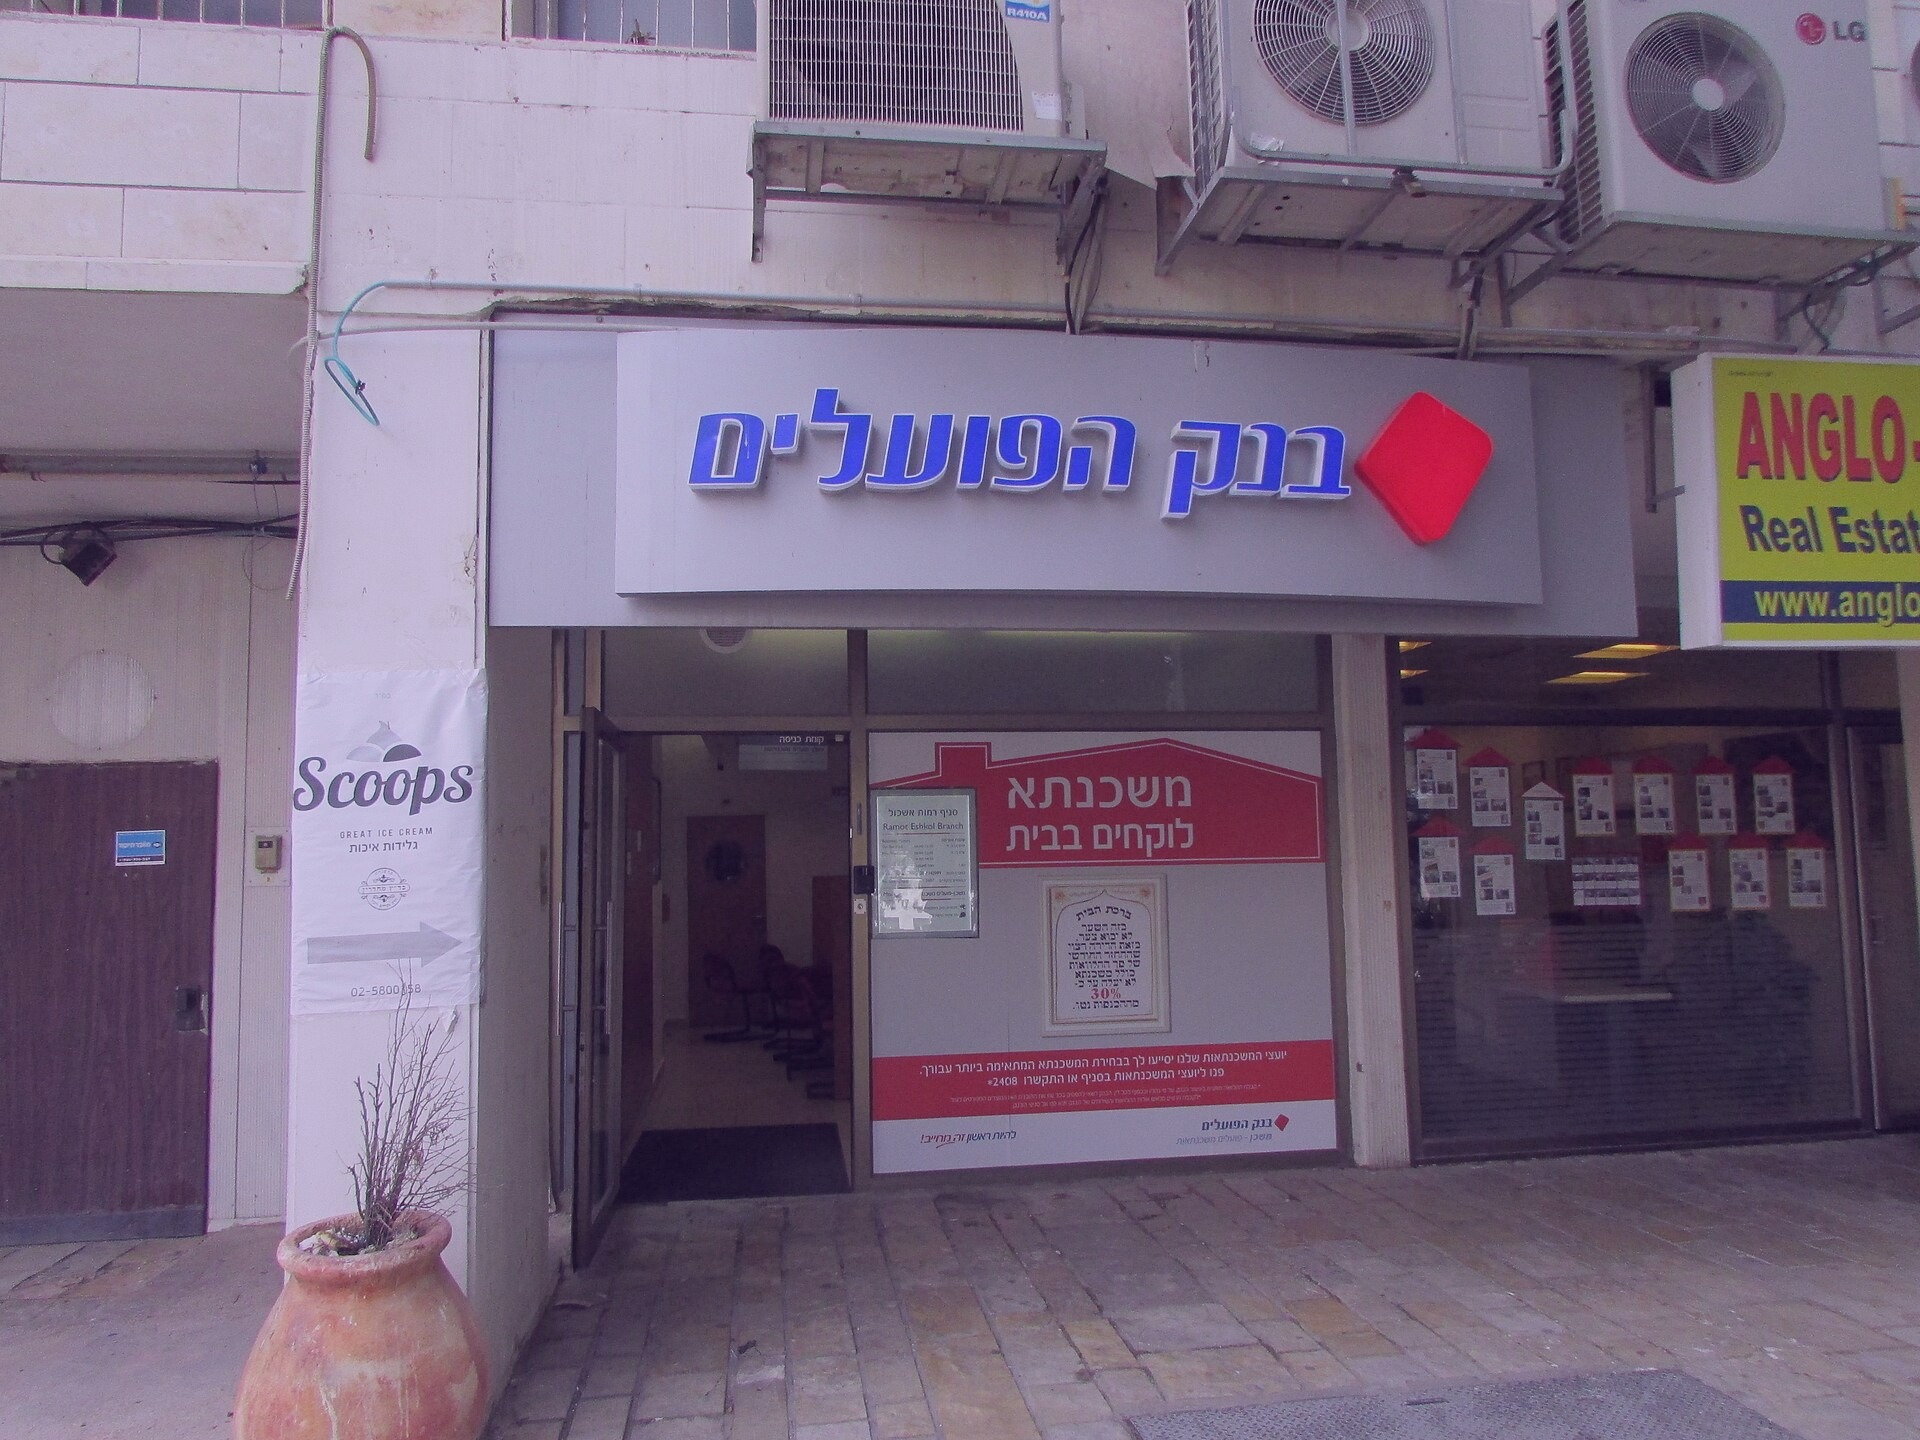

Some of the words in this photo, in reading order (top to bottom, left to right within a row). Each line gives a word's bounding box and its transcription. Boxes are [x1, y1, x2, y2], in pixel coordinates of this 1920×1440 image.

[1006, 7, 1047, 20] R410A
[1832, 21, 1867, 42] LG
[687, 387, 1137, 492] הפועלים
[1160, 420, 1351, 519] בנק
[1739, 504, 1824, 552] Real
[779, 735, 802, 743] כניסה
[293, 756, 474, 816] Scoops
[1007, 775, 1192, 809] משכנתא
[888, 807, 915, 817] אשכול
[917, 808, 937, 817] רמות
[940, 808, 958, 818] סניף
[911, 822, 935, 830] Eshkol
[937, 821, 964, 830] Branch
[339, 829, 372, 839] GREAT
[378, 828, 393, 837] ICE
[398, 827, 433, 836] CREAM
[1006, 823, 1083, 851] בבית
[1092, 818, 1194, 858] לוקחים
[348, 842, 380, 853] איכות
[382, 839, 418, 851] גלידות
[1075, 906, 1102, 921] הבית
[1105, 905, 1132, 920] ברכת
[1081, 923, 1108, 932] השער
[1121, 932, 1133, 940] לא
[1068, 951, 1102, 960] החודשי
[1069, 960, 1110, 969] ההלוואות
[1127, 959, 1141, 967] של
[1075, 970, 1113, 978] משכנתא
[1115, 969, 1136, 977] כולל
[1087, 979, 1099, 987] על
[1101, 979, 1122, 987] יעלה
[1125, 978, 1137, 986] לא
[1090, 987, 1121, 1000] 30%
[1093, 1000, 1139, 1009] מההכנסות
[1148, 1055, 1175, 1065] יסייעו
[1177, 1053, 1200, 1064] שלנו
[1202, 1051, 1263, 1063] המשכנתאות
[1265, 1050, 1287, 1060] יועצי
[986, 1060, 1035, 1072] המתאימה
[1038, 1058, 1089, 1070] המשכנתא
[1091, 1056, 1130, 1069] בבחירת
[1133, 1055, 1145, 1068] לך
[919, 1064, 953, 1077] עבורך.
[955, 1063, 983, 1073] ביותר
[1177, 1067, 1206, 1079] ליועצי
[1209, 1067, 1225, 1077] פנו
[1023, 1074, 1065, 1087] התקשרו
[1067, 1073, 1078, 1083] או
[1081, 1072, 1111, 1085] בסניף
[1113, 1070, 1175, 1082] המשכנתאות
[1201, 1118, 1249, 1131] הפועלים
[1251, 1118, 1273, 1130] בנק
[920, 1134, 952, 1144] מחייב!
[953, 1133, 966, 1142] זה
[966, 1132, 991, 1143] ראשון
[992, 1130, 1017, 1140] להיות
[1175, 1135, 1217, 1146] משכנתאות
[1249, 1133, 1273, 1143] משכן
